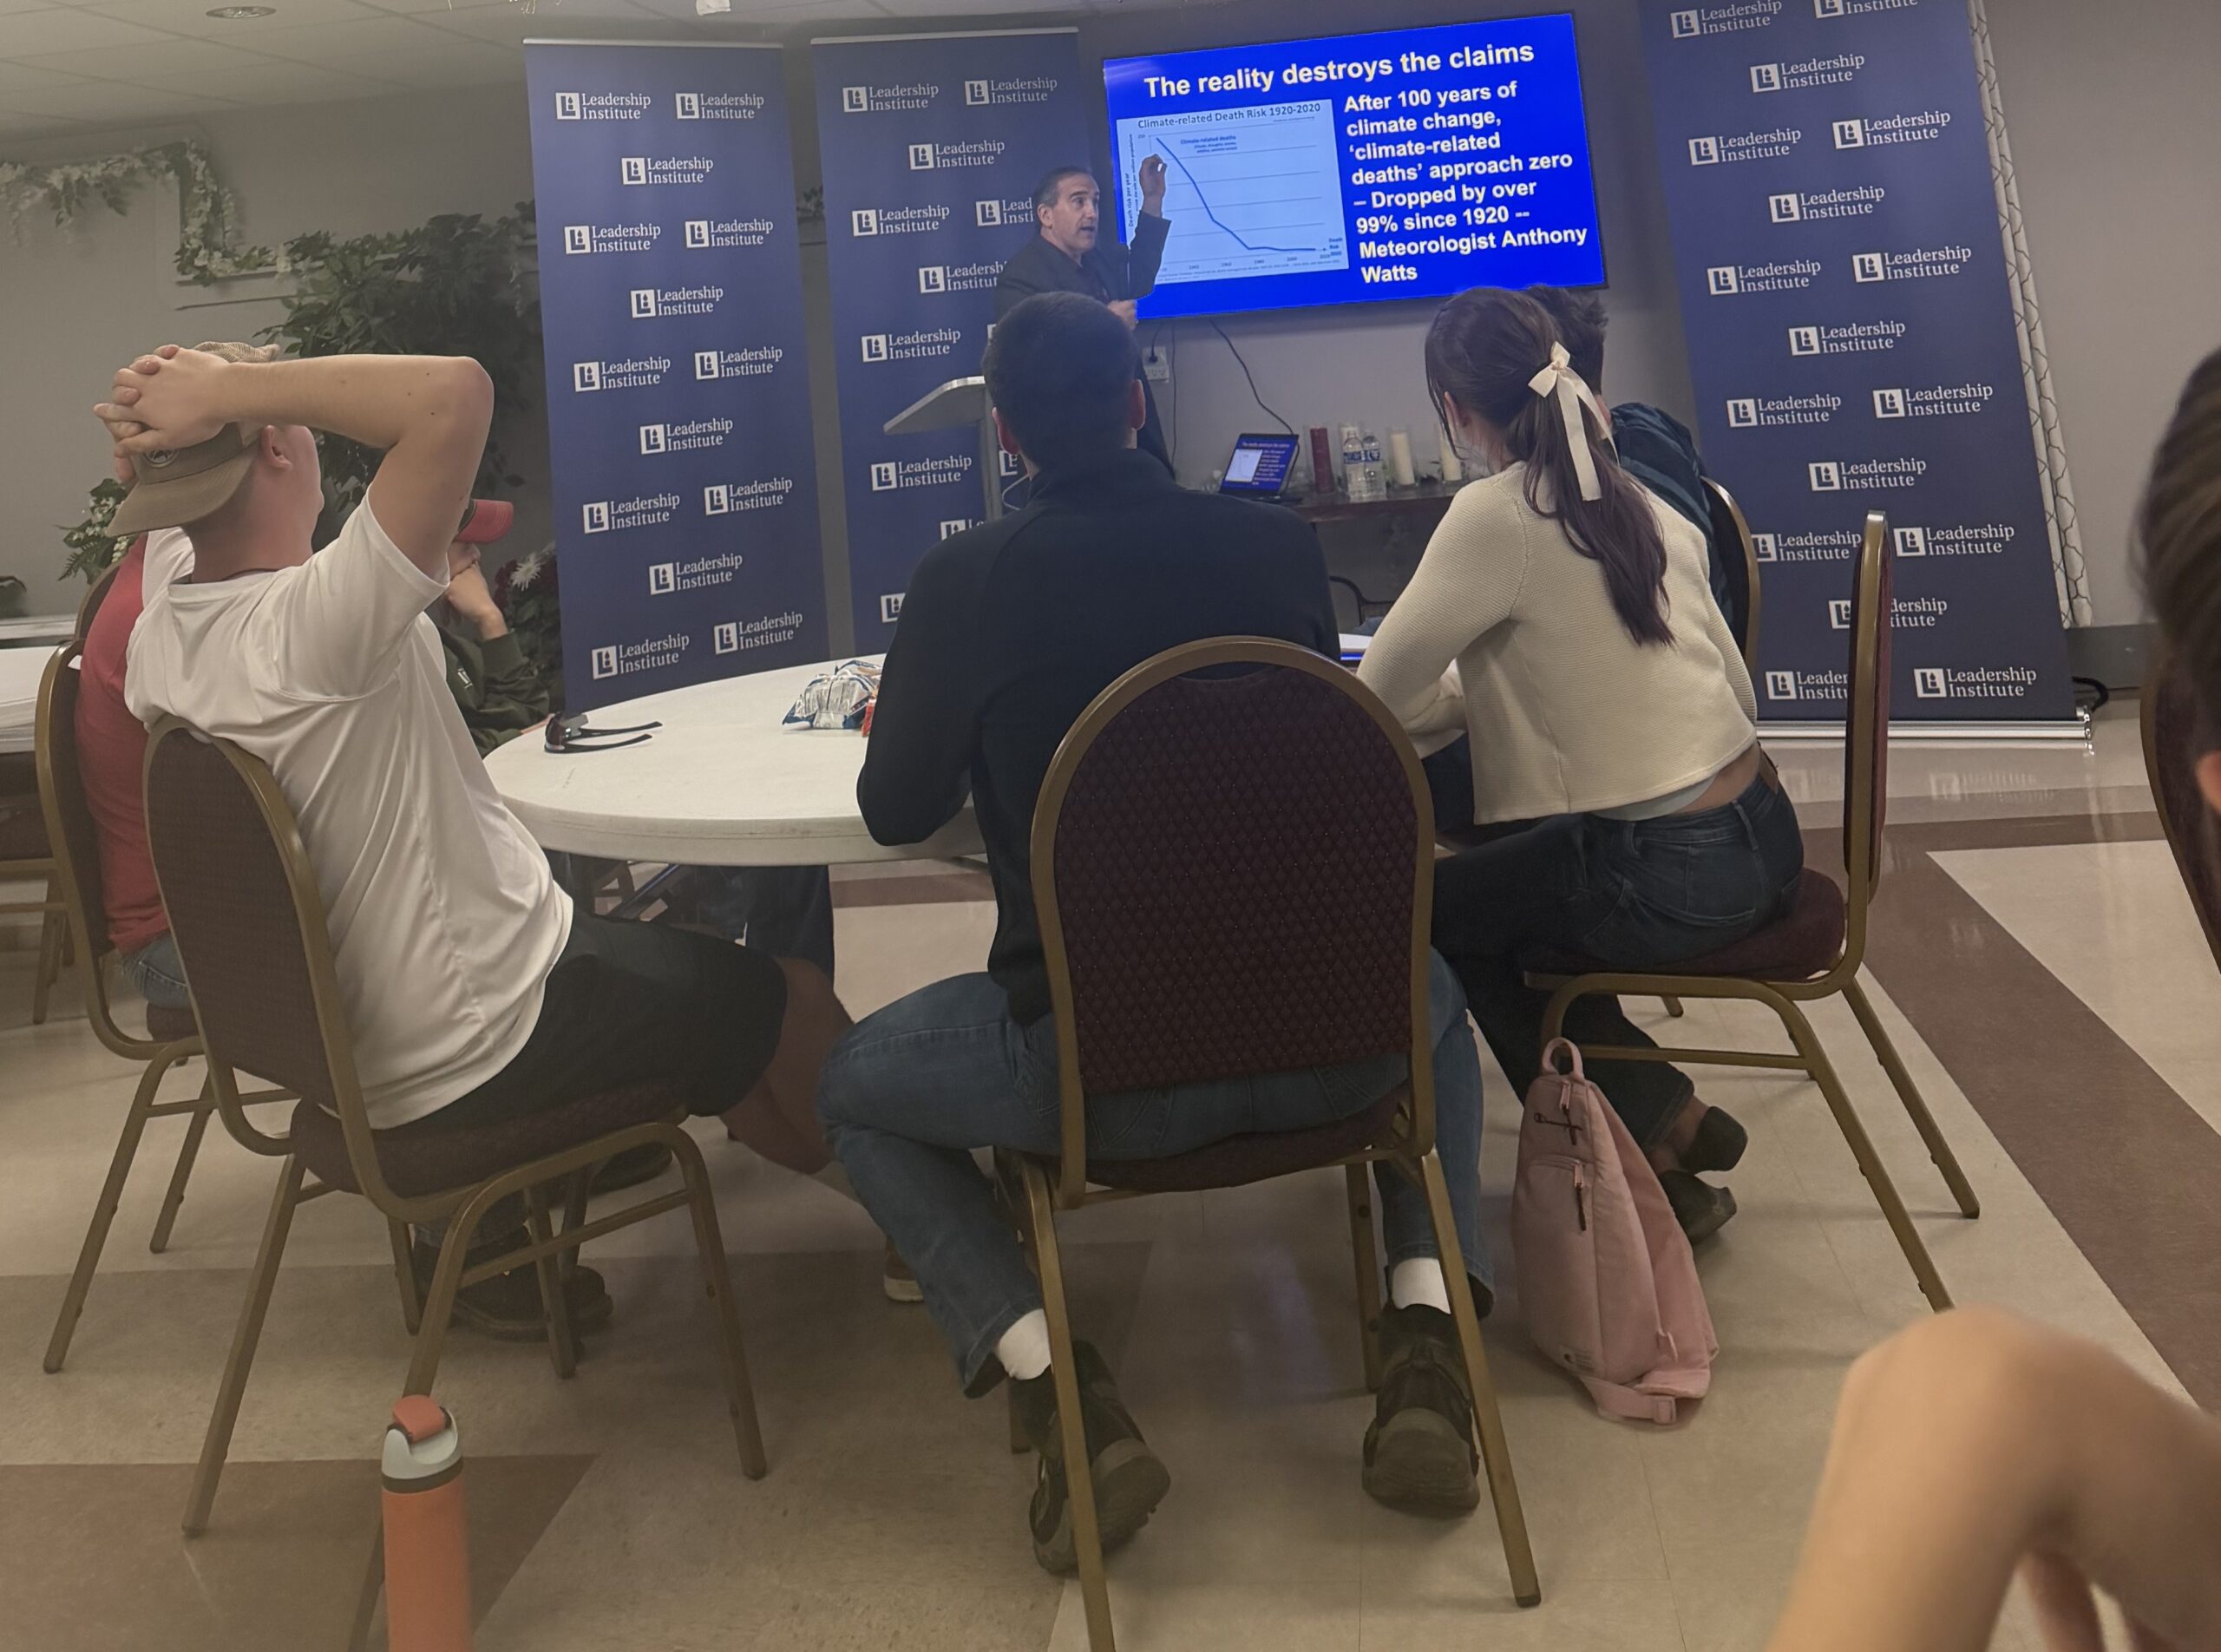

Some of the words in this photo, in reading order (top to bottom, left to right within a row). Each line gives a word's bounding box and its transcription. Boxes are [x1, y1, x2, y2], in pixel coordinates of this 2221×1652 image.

[1700, 0, 1782, 21] Leadership
[1702, 16, 1771, 35] Institute
[1144, 76, 1190, 97] The
[1198, 68, 1274, 93] reality
[1282, 59, 1393, 84] destroys
[1400, 51, 1441, 73] the
[1450, 44, 1534, 69] claims
[1781, 54, 1864, 75] Leadership
[991, 77, 1057, 92] Leadership
[1783, 69, 1853, 88] Institute
[868, 84, 939, 99] Leadership
[991, 90, 1048, 104] Institute
[1344, 95, 1392, 112] After
[1398, 88, 1431, 107] 100
[1437, 85, 1490, 107] years
[1497, 81, 1517, 98] of
[582, 93, 651, 108] Leadership
[700, 94, 764, 108] Leadership
[869, 97, 928, 111] Institute
[583, 108, 640, 120] Institute
[701, 108, 755, 120] Institute
[1138, 114, 1212, 128] Climate-related
[1215, 110, 1244, 121] Death
[1247, 108, 1267, 118] Risk
[1270, 103, 1320, 115] 1920-2020
[1864, 111, 1950, 132] Leadership
[1346, 117, 1417, 136] climate
[1423, 111, 1501, 130] change,
[1719, 128, 1801, 148] Leadership
[1866, 127, 1938, 146] Institute
[935, 141, 1005, 154] Leadership
[1720, 144, 1790, 162] Institute
[647, 157, 714, 173] Leadership
[936, 154, 994, 167] Institute
[648, 172, 704, 184] Institute
[1352, 164, 1423, 185] deaths’
[1430, 155, 1523, 181] approach
[1529, 154, 1573, 170] zero
[1371, 186, 1456, 209] Dropped
[1462, 184, 1485, 204] by
[1492, 181, 1536, 199] over
[1800, 186, 1884, 206] Leadership
[879, 205, 950, 220] Leadership
[1003, 210, 1033, 224] Insti
[1802, 201, 1873, 220] Institute
[711, 219, 774, 233] Leadership
[880, 220, 939, 234] Institute
[1357, 215, 1399, 234] 99%
[1404, 213, 1457, 229] since
[1463, 206, 1509, 225] 1920
[592, 224, 661, 239] Leadership
[711, 233, 763, 246] Institute
[593, 238, 651, 252] Institute
[1359, 232, 1497, 259] Meteorologist
[1502, 227, 1588, 246] Anthony
[1884, 246, 1971, 266] Leadership
[947, 261, 1006, 278] Leadersh
[1361, 266, 1418, 283] Watts
[1738, 260, 1821, 279] Leadership
[1887, 262, 1959, 279] Institute
[947, 277, 997, 291] Institut
[1740, 275, 1810, 292] Institute
[657, 286, 724, 302] Leadership
[658, 301, 713, 316] Institute
[888, 329, 960, 346] Leadership
[1820, 321, 1905, 340] Leadership
[889, 343, 950, 359] Institute
[1822, 336, 1894, 353] Institute
[720, 347, 783, 364] Leadership
[601, 357, 671, 375] Leadership
[720, 361, 773, 378] Institute
[602, 372, 660, 389] Institute
[1905, 384, 1993, 403] Leadership
[1758, 394, 1841, 412] Leadership
[1907, 399, 1982, 416] Institute
[1759, 410, 1830, 425] Institute
[666, 418, 733, 436] Leadership
[667, 434, 723, 451] Institute
[898, 456, 972, 474] Leadership
[1841, 458, 1926, 475] Leadership
[729, 477, 792, 497] Leadership
[899, 470, 961, 488] Institute
[1842, 474, 1915, 489] Institute
[610, 493, 680, 514] Leadership
[731, 493, 783, 512] Institute
[611, 509, 670, 529] Institute
[1777, 531, 1862, 547] Leadership
[1926, 524, 2015, 542] Leadership
[1779, 546, 1850, 561] Institute
[1929, 540, 2002, 555] Institute
[676, 553, 743, 574] Leadership
[677, 569, 732, 591] Institute
[1890, 597, 1947, 614] dership
[738, 611, 803, 635] Leadership
[1890, 613, 1936, 627] titute
[619, 633, 689, 658] Leadership
[740, 627, 794, 650] Institute
[619, 651, 679, 673] Institute
[1796, 670, 1848, 685] Leader
[1947, 667, 2036, 685] Leadership
[1798, 685, 1847, 699] Instit
[1949, 682, 2024, 698] Institute
